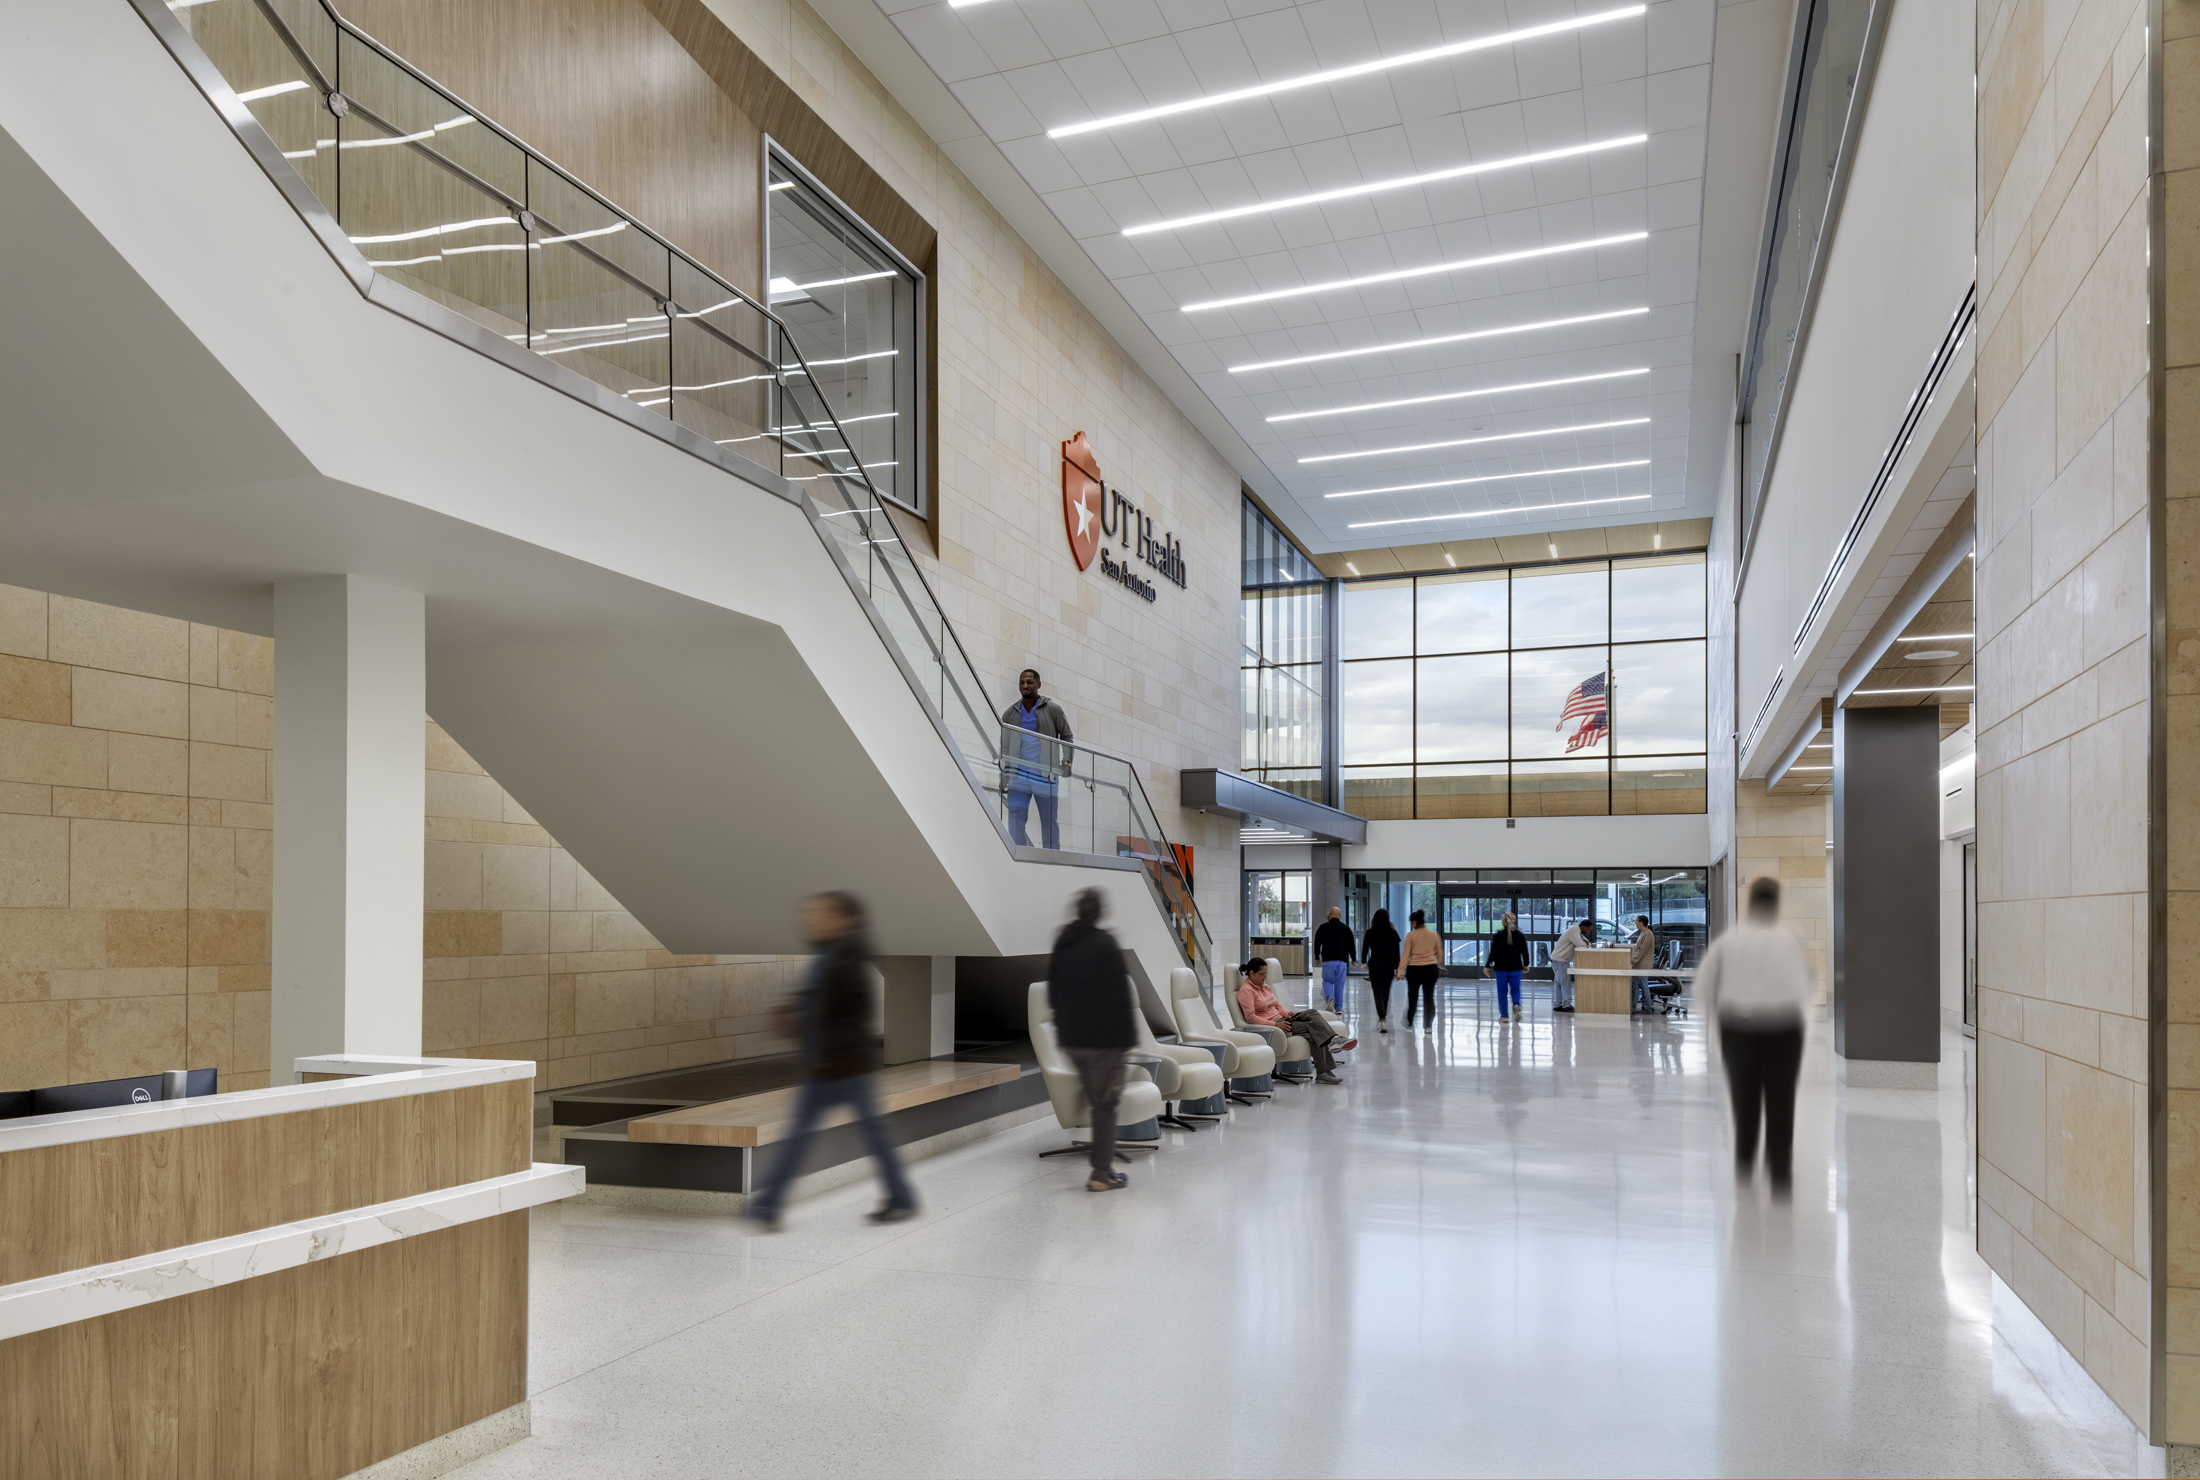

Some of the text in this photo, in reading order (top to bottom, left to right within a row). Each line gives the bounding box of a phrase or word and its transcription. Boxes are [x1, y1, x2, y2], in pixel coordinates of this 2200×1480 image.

[1100, 480, 1187, 589] UT Health
[1101, 547, 1157, 602] San Antonio
[134, 1094, 149, 1102] DELL
